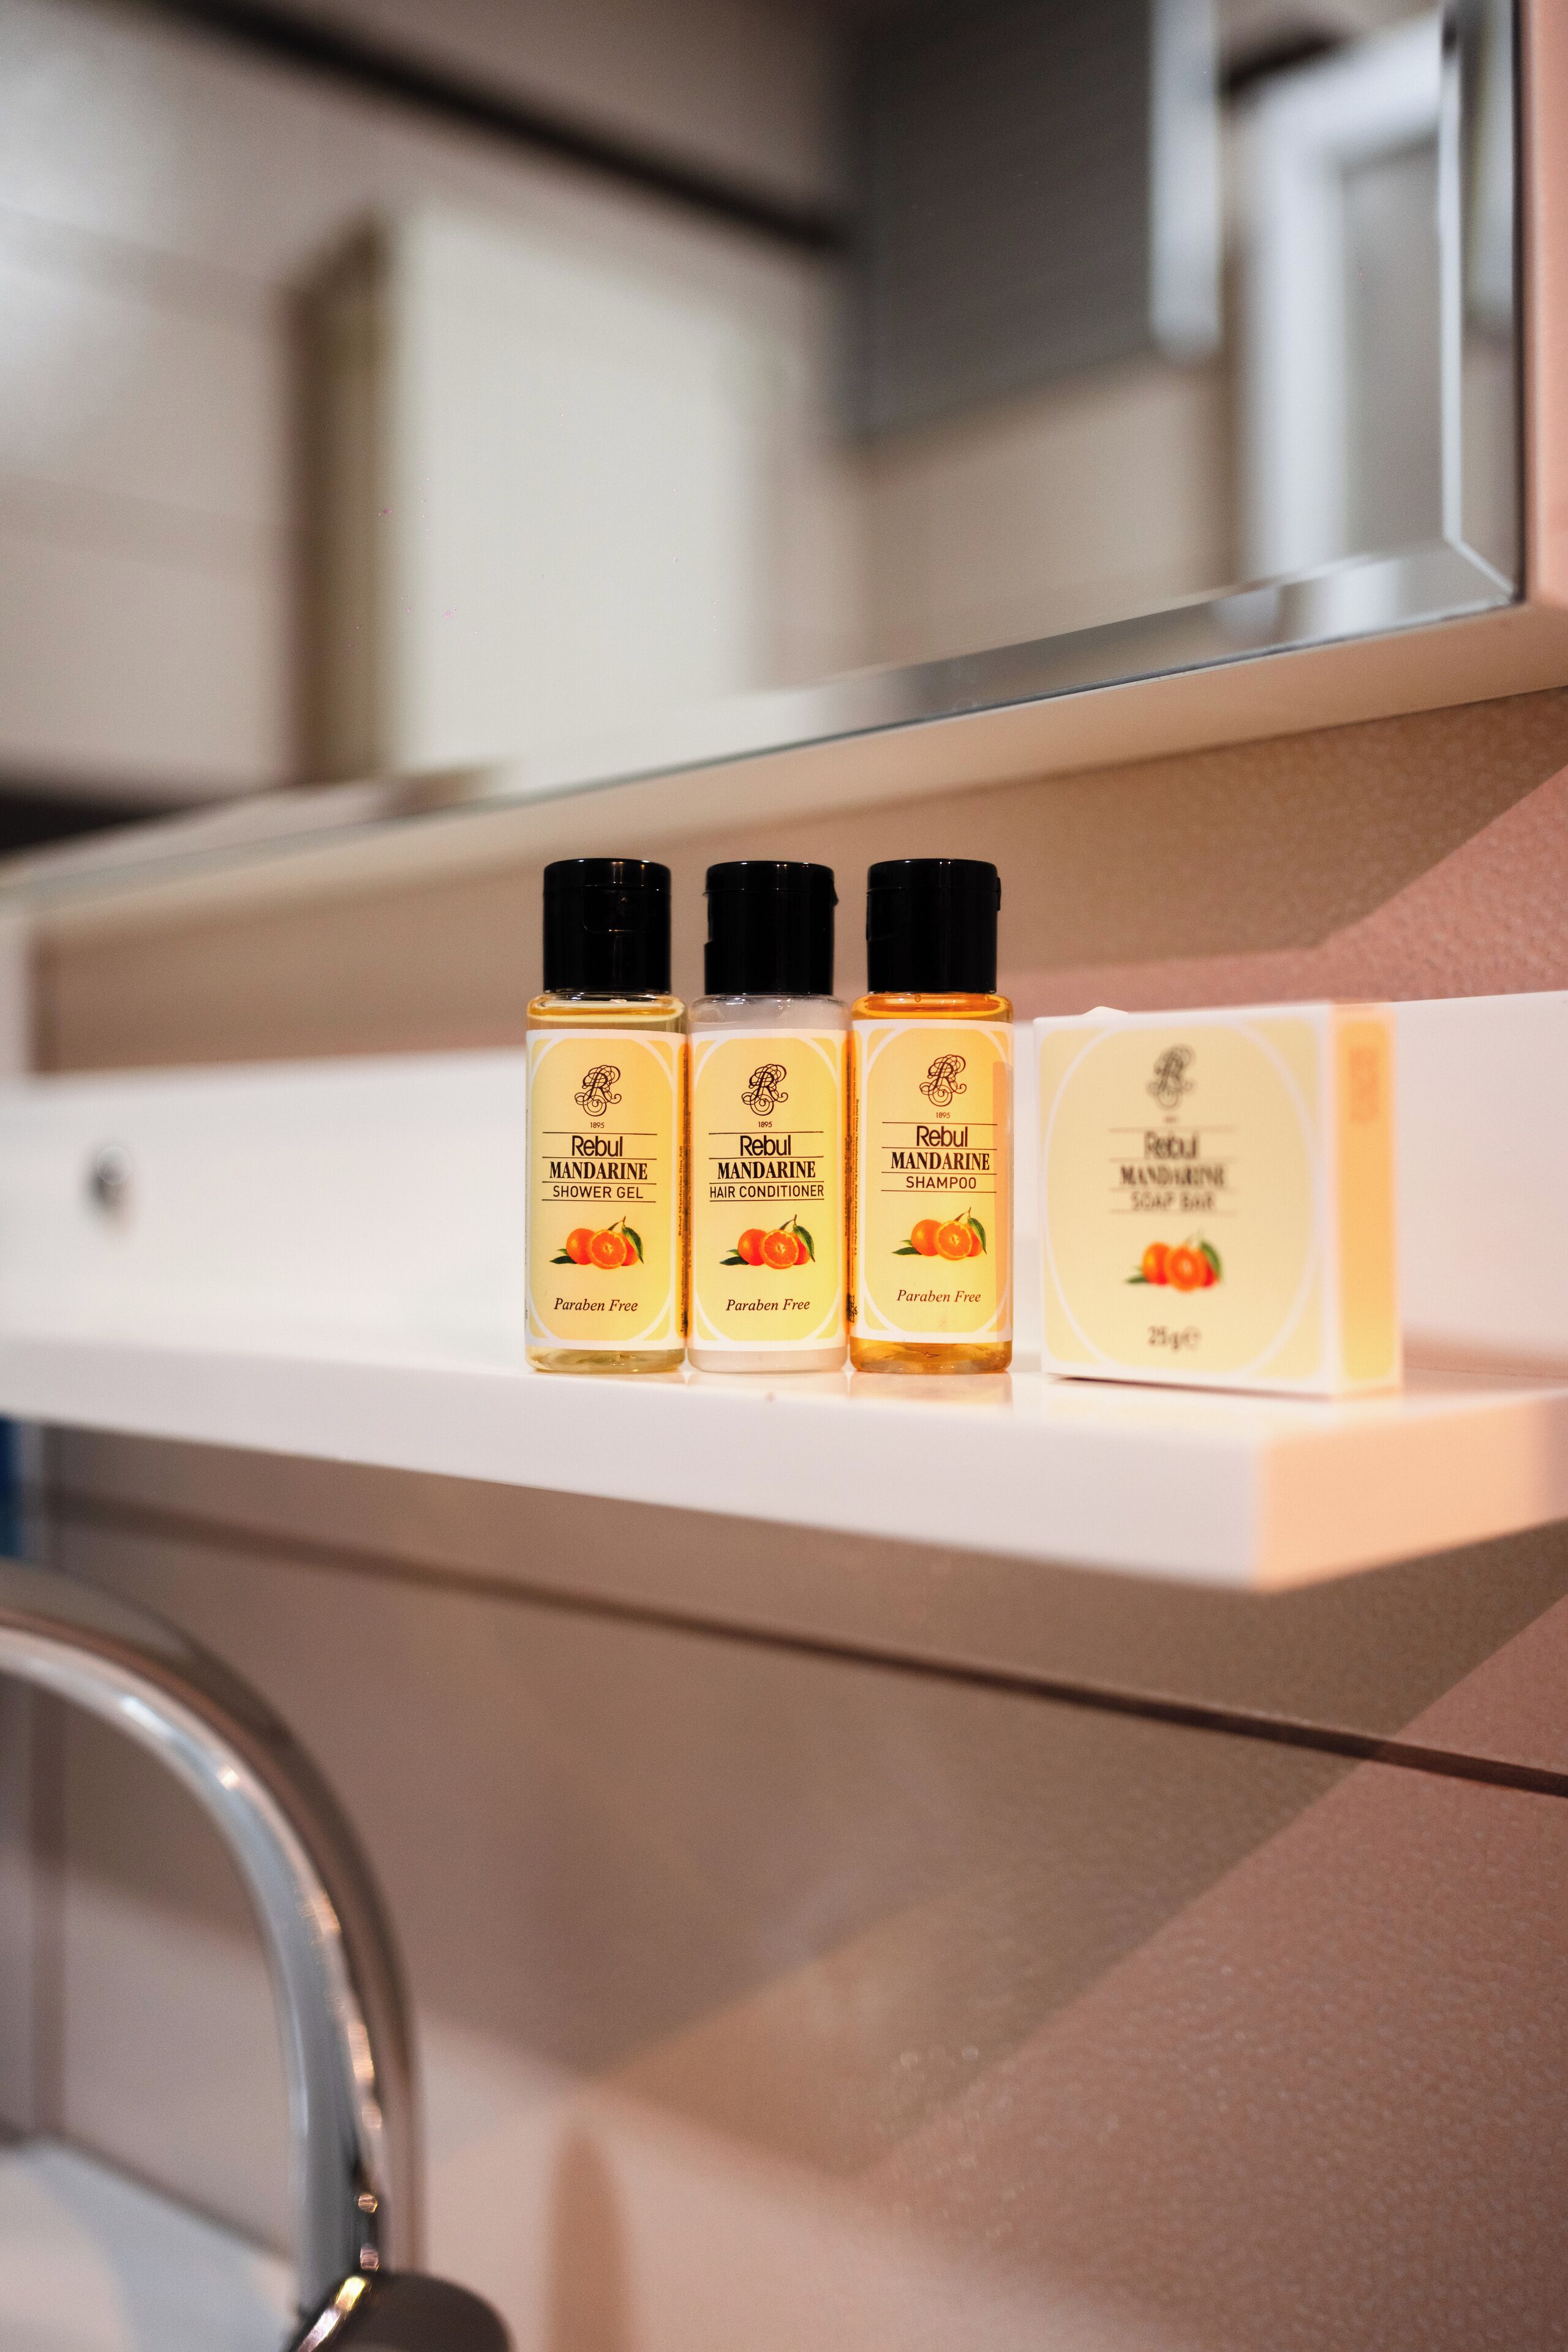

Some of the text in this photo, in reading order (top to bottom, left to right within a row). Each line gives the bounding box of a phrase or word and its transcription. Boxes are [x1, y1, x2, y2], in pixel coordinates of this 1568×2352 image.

[740, 1134, 791, 1156] Rebul
[916, 1125, 968, 1147] Rebul
[1144, 1131, 1199, 1159] Rebul
[571, 1135, 623, 1157] Rebul
[549, 1161, 648, 1180] MANDARINE
[717, 1161, 816, 1180] MANDARINE
[891, 1152, 990, 1170] MANDARINE
[906, 1176, 976, 1189] SHAMPOO
[1119, 1164, 1225, 1187] MANDARINE
[552, 1185, 644, 1199] SHOWER GEL
[710, 1185, 824, 1198] HAIR CONDITIONER
[1131, 1191, 1215, 1212] SOAP BAR
[554, 1297, 638, 1312] Paraben Free
[726, 1298, 810, 1311] Paraben Free
[897, 1289, 981, 1302] Paraben Free
